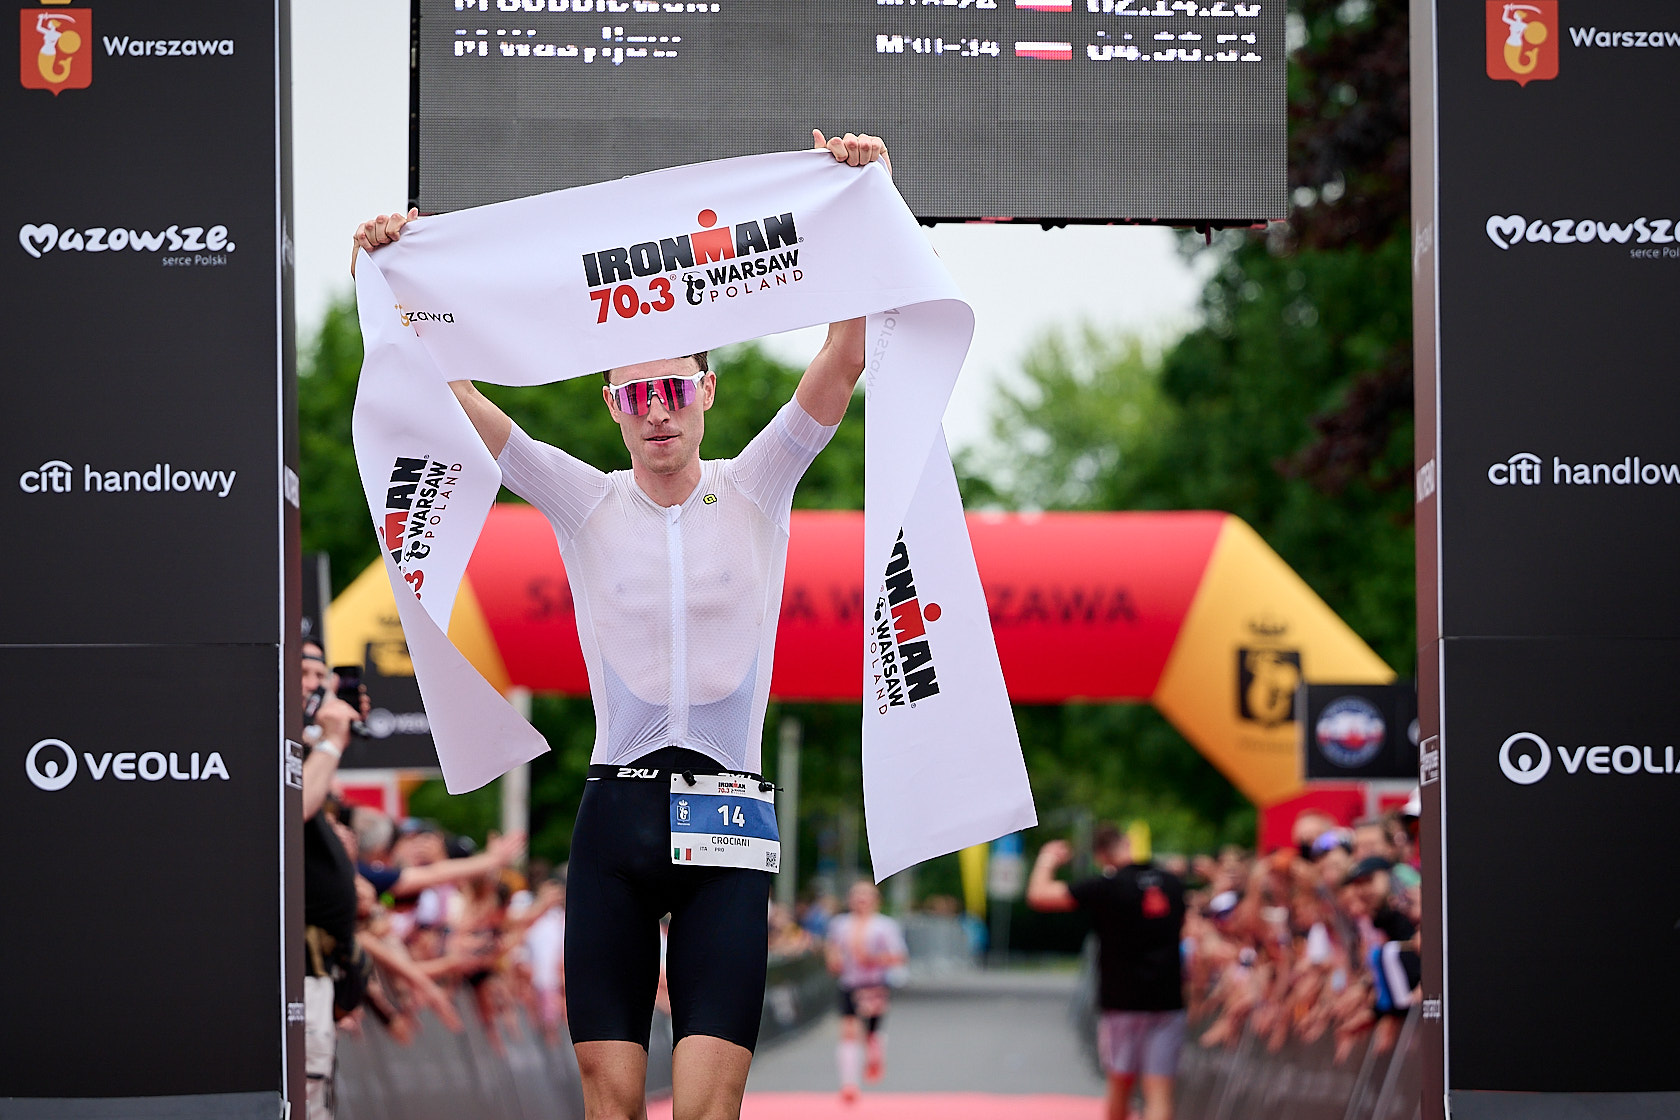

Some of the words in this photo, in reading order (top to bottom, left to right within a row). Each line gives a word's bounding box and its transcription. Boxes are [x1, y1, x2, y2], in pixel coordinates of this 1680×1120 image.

[103, 36, 235, 56] Warszawa
[1568, 27, 1680, 48] Warszaw
[582, 208, 798, 288] IRONMAN
[1486, 215, 1680, 250] Mazowsz
[162, 255, 192, 266] serce
[194, 254, 228, 266] Polski
[1630, 249, 1660, 259] serce
[590, 277, 675, 324] 70.3
[706, 249, 799, 286] WARSAW
[709, 269, 804, 302] POLAND
[19, 460, 73, 494] citi
[84, 463, 237, 498] handlowy
[1488, 452, 1542, 486] citi
[1553, 456, 1680, 485] handlow
[408, 461, 448, 539] WARSAW
[425, 463, 462, 539] POLAND
[877, 619, 905, 707] WARSAW
[83, 752, 231, 782] VEOLIA
[617, 768, 659, 779] 2XU
[1556, 745, 1680, 774] VEOLI
[717, 805, 746, 827] 14
[711, 836, 750, 847] CROCIANI
